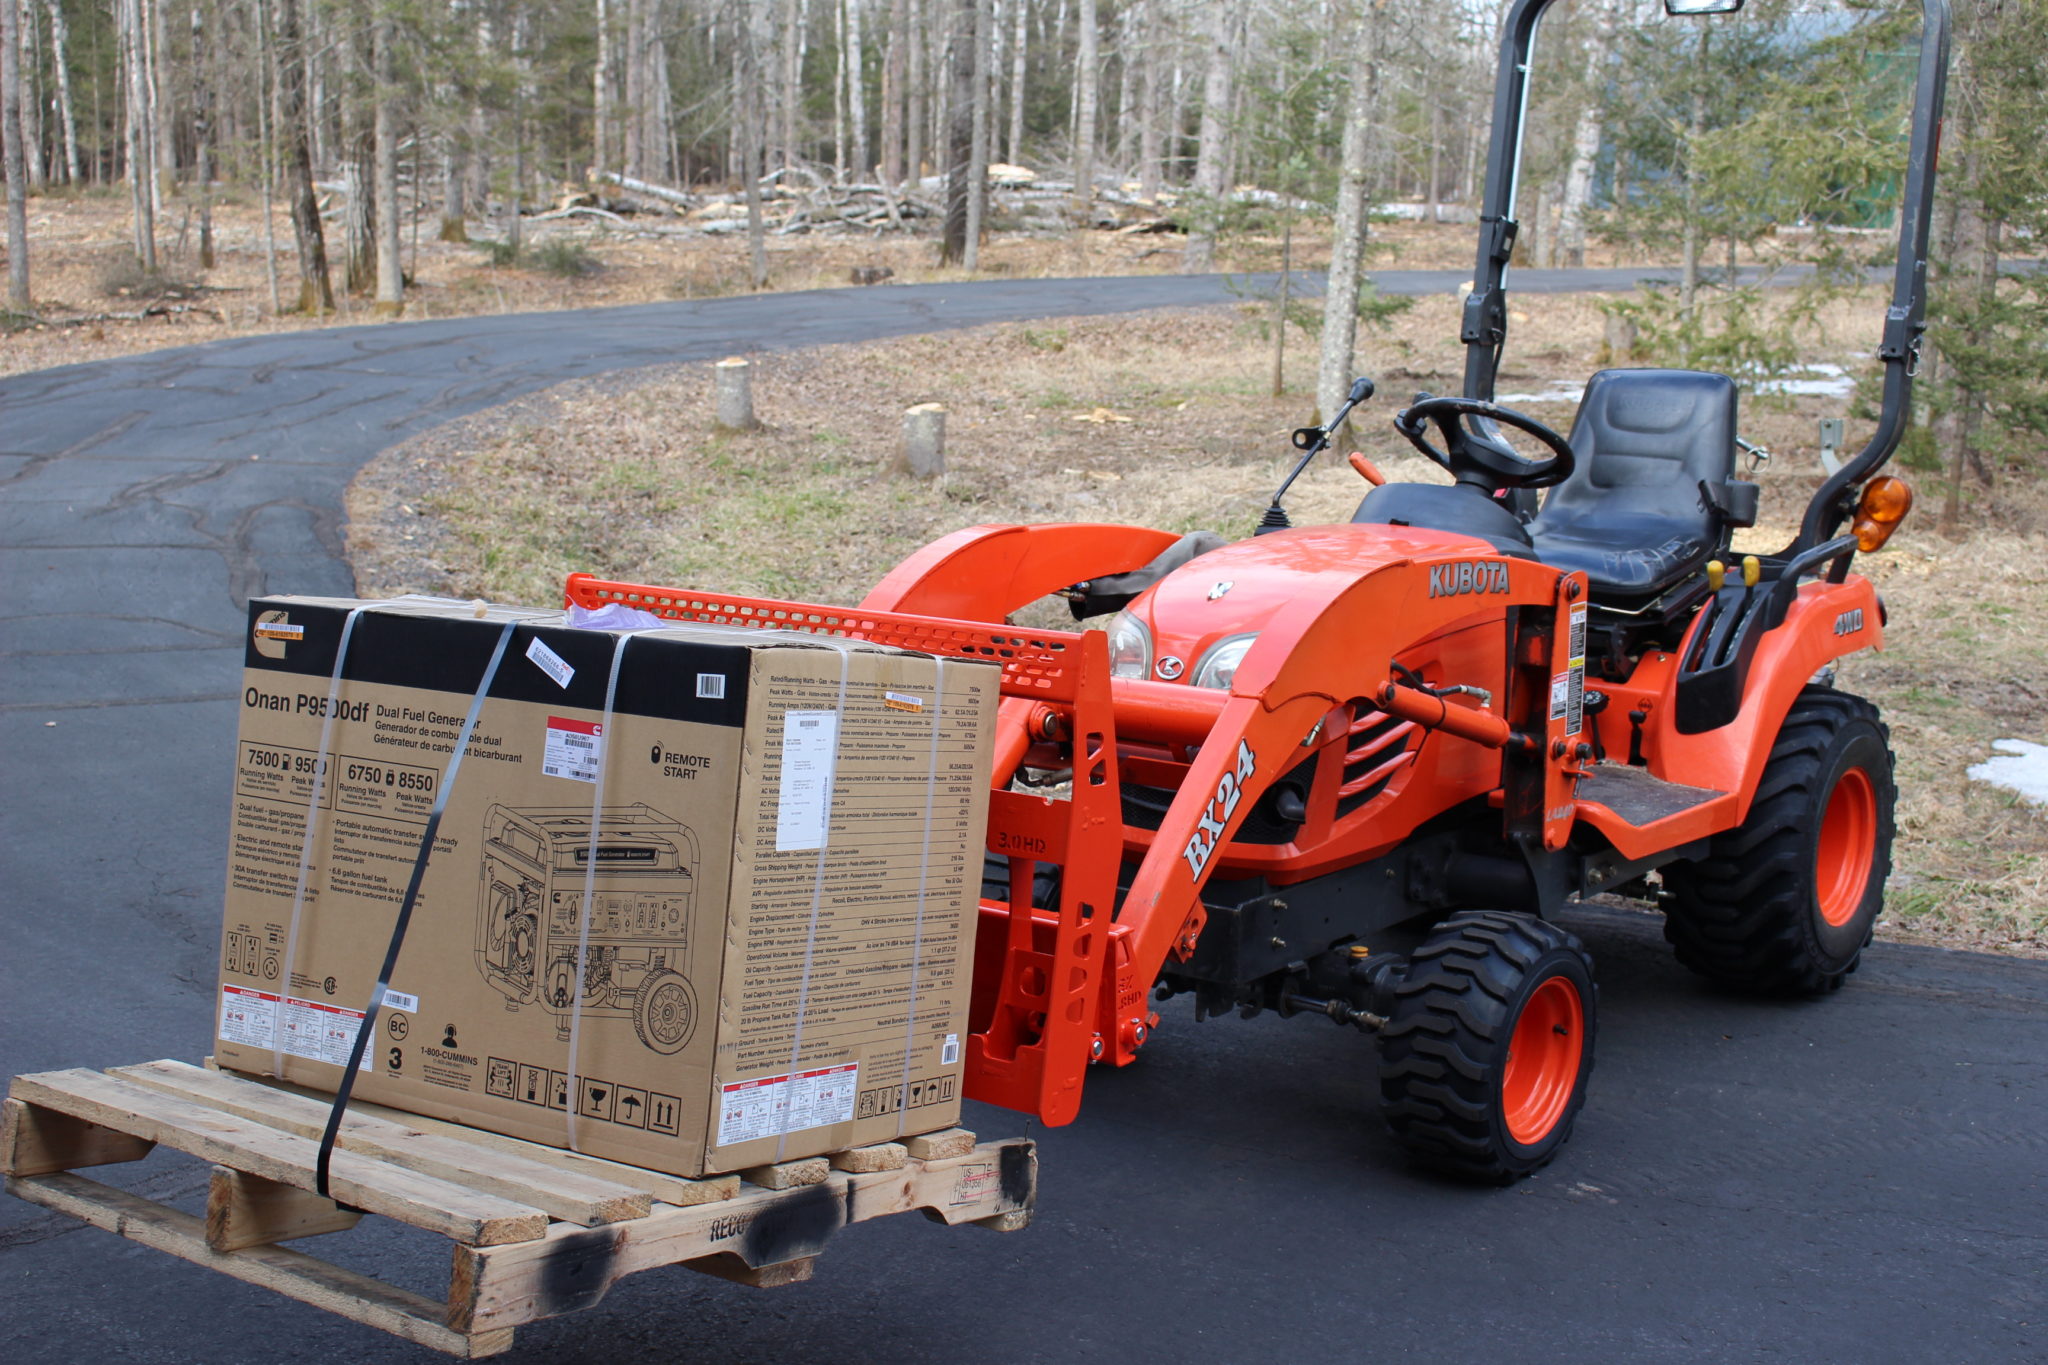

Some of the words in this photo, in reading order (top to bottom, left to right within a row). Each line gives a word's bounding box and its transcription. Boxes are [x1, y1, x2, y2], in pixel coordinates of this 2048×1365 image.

[1430, 560, 1510, 598] KUBOTA
[1833, 608, 1863, 636] 4WD
[245, 687, 291, 712] Onan
[377, 705, 400, 719] Dual
[403, 708, 425, 722] Fuel
[428, 712, 481, 729] Generar
[375, 721, 417, 735] Generador
[419, 726, 429, 736] de
[431, 728, 481, 743] combuble
[484, 735, 502, 746] dual
[374, 734, 418, 749] Générateur
[420, 740, 430, 751] de
[432, 741, 472, 756] carbunt
[474, 747, 522, 763] bicarburant
[248, 749, 279, 768] 7500
[665, 753, 710, 768] REMOTE
[240, 768, 265, 780] Running
[267, 772, 283, 781] Watts
[291, 776, 306, 785] Peak
[348, 764, 381, 784] 6750
[399, 772, 433, 792] 8550
[664, 766, 697, 780] START
[340, 783, 367, 795] Running
[369, 788, 386, 797] Watts
[396, 792, 413, 801] Peak
[415, 795, 433, 804] Watts
[240, 803, 252, 811] Dual
[1183, 738, 1256, 883] BX24
[336, 820, 361, 830] Portable
[362, 824, 392, 835] automatic
[394, 829, 418, 839] transfer
[237, 834, 258, 844] Electric
[259, 838, 270, 846] and
[271, 840, 291, 849] remote
[441, 837, 458, 847] ready
[247, 867, 268, 877] transfer
[270, 871, 287, 880] switch
[343, 870, 360, 879] gallon
[362, 873, 373, 881] fuel
[374, 875, 388, 883] tank
[751, 903, 768, 911] Starting
[391, 1021, 406, 1034] BC
[389, 1046, 403, 1070] 3
[421, 1046, 478, 1066] 1-800-CUMMINS
[738, 1052, 747, 1060] Part
[748, 1050, 765, 1058] Number
[736, 1063, 758, 1073] Generator
[759, 1061, 774, 1069] Weight
